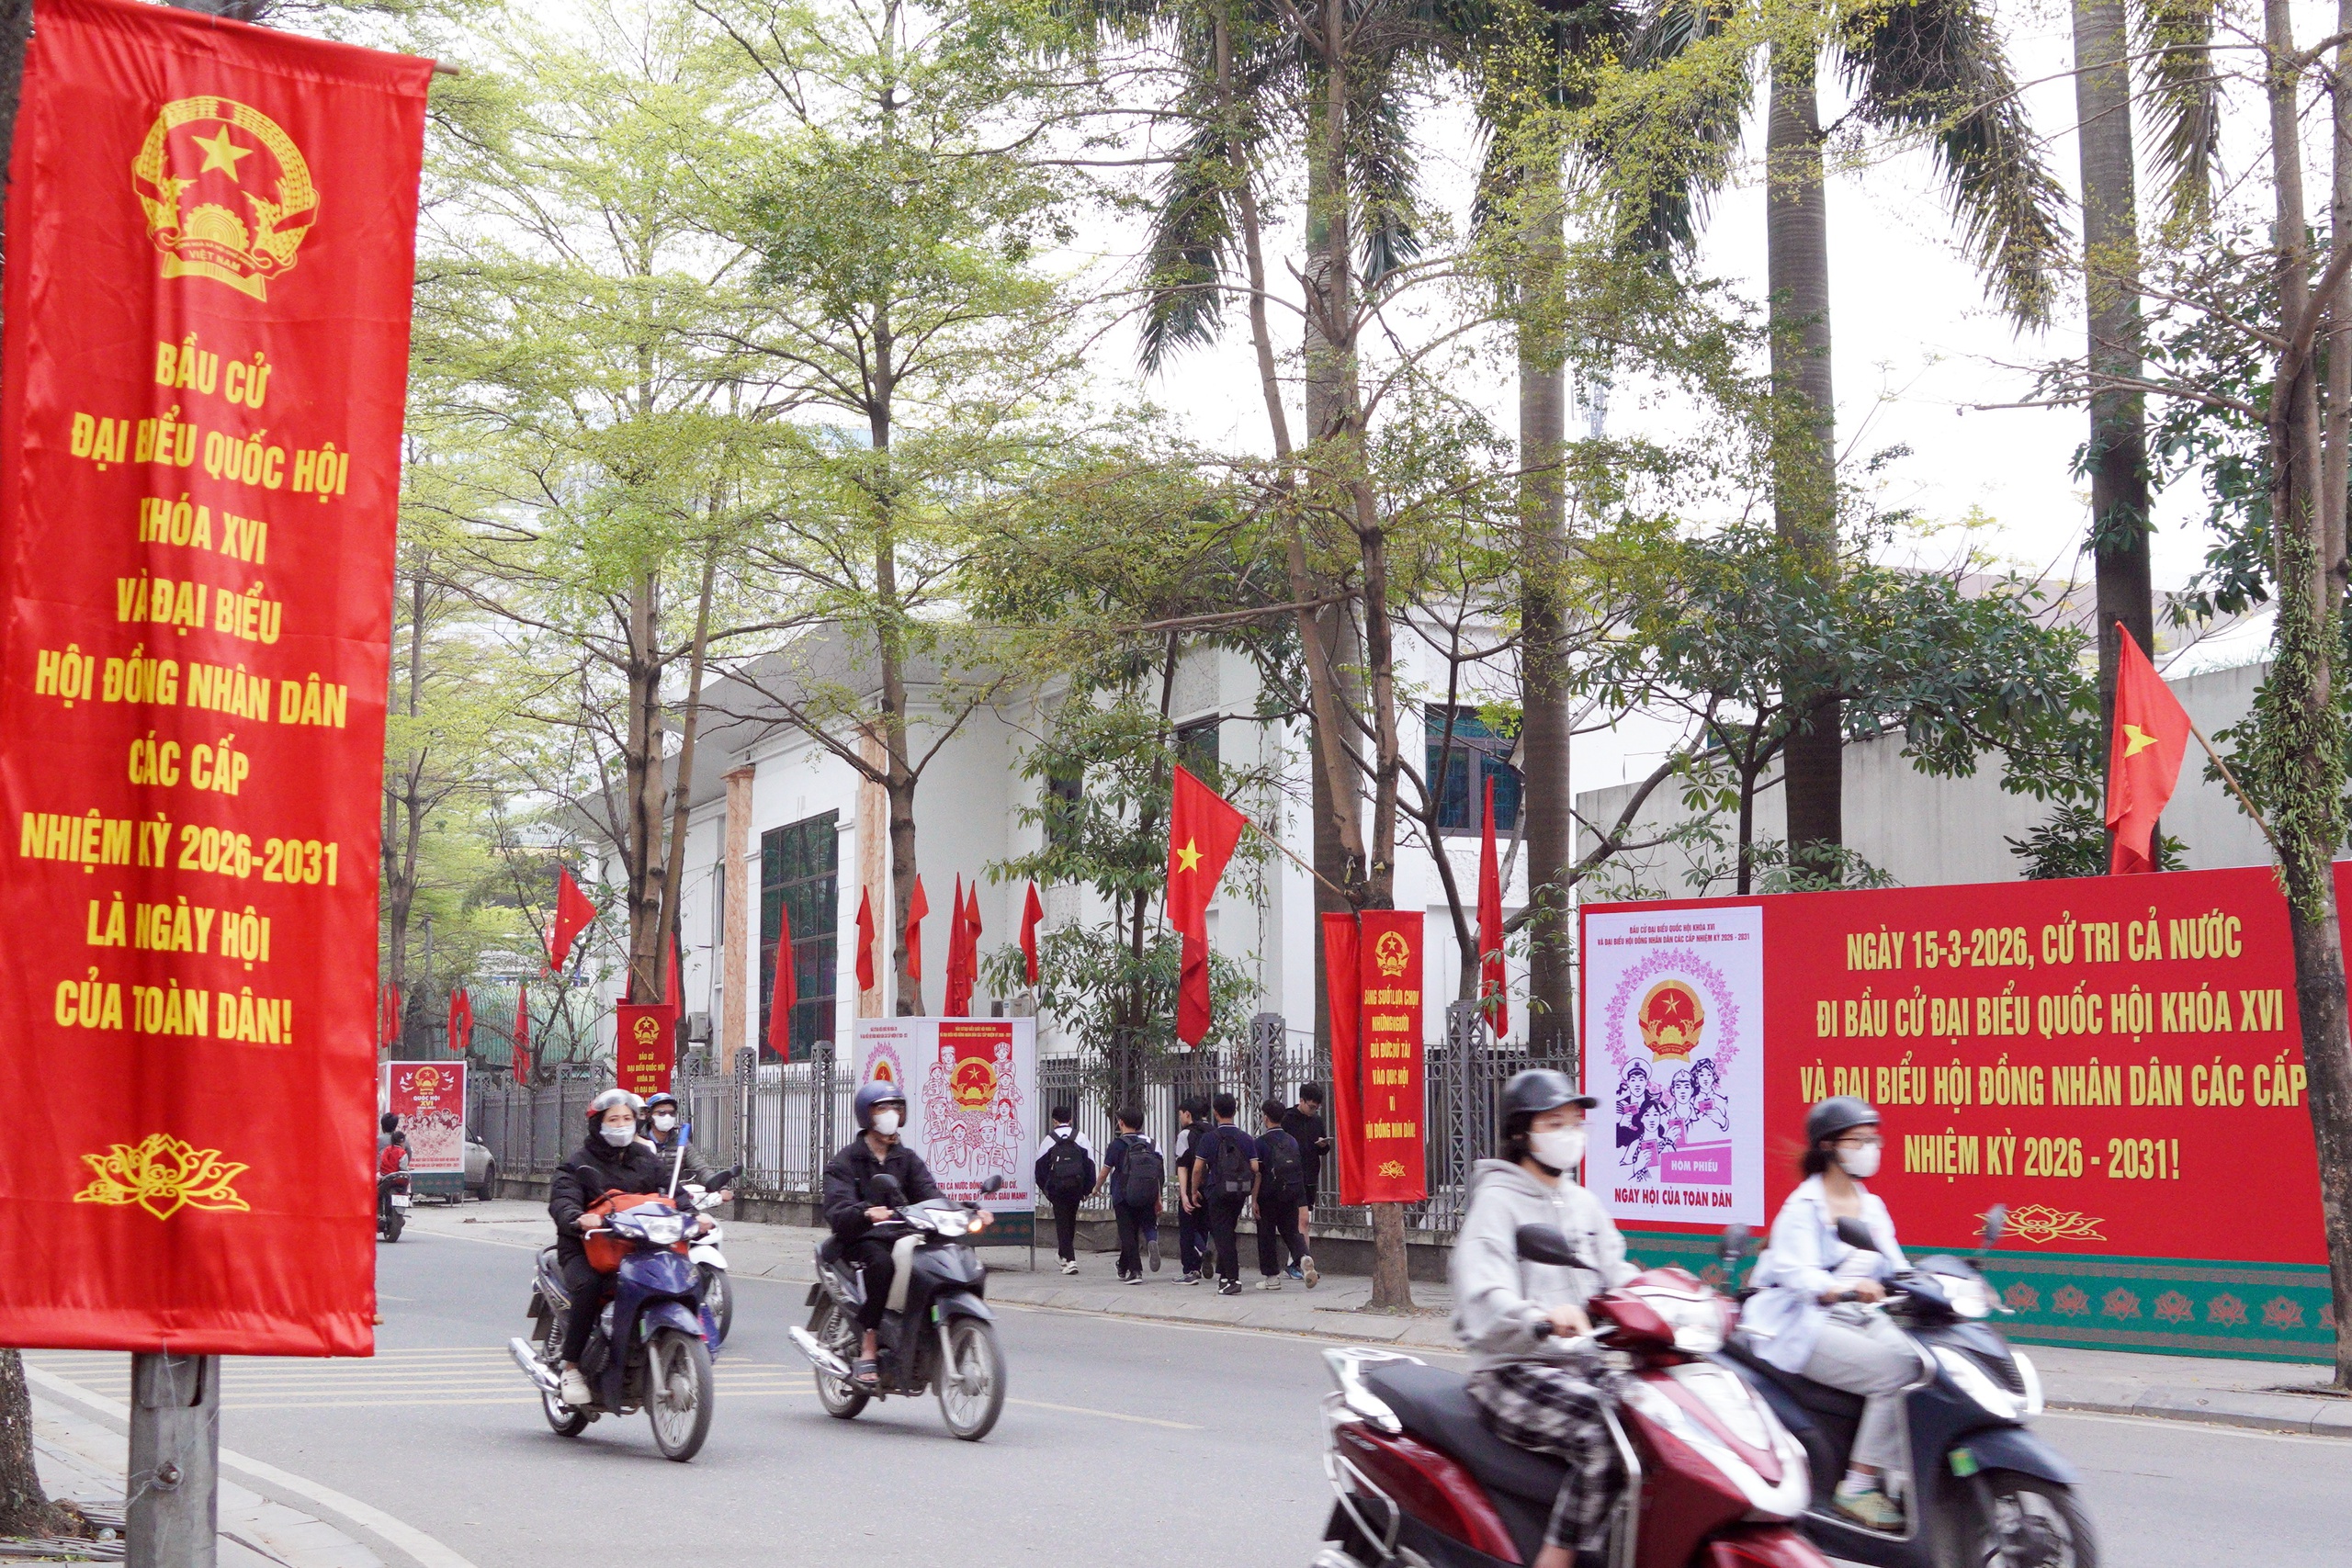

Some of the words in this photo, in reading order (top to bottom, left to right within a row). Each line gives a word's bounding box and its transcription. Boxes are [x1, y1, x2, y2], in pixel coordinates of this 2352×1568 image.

[216, 254, 242, 272] NAM
[154, 331, 220, 396] BẦU
[223, 351, 273, 410] CỬ
[71, 412, 130, 471] ĐẠI
[134, 404, 198, 468] BIỂU
[202, 428, 286, 491] QUỐC
[292, 441, 350, 503] HỘI
[219, 511, 268, 566] XVI
[151, 577, 209, 637] ĐẠI
[213, 580, 282, 645] BIỂU
[35, 643, 95, 708] HỘI
[102, 642, 179, 705] ĐỒNG
[187, 653, 271, 723] NHÂN
[278, 671, 348, 729] DÂN
[129, 730, 181, 787] CÁC
[190, 732, 250, 796] CẤP
[19, 807, 132, 874] NHIỆM
[139, 811, 173, 868] KỲ
[178, 824, 339, 886] 2026-2031
[86, 891, 126, 947] LÀ
[135, 895, 216, 953] NGÀY
[220, 905, 271, 972] HỘI
[1847, 924, 1905, 971] NGÀY
[1912, 927, 2035, 969] 15-3-2026,
[2041, 910, 2077, 964] CỬ
[2081, 922, 2120, 963] TRI
[2128, 906, 2163, 962] CẢ
[2169, 908, 2242, 960] NƯỚC
[54, 965, 122, 1030] CỦA
[132, 977, 209, 1037] TOÀN
[217, 986, 292, 1044] DÂN!
[1816, 1000, 1838, 1038] ĐI
[1845, 985, 1888, 1037] BẦU
[1894, 986, 1927, 1037] CỬ
[1930, 998, 1969, 1044] ĐẠI
[1976, 980, 2030, 1036] BIỂU
[2038, 980, 2103, 1040] QUỐC
[2110, 984, 2154, 1043] HỘI
[2161, 982, 2233, 1033] KHÓA
[2239, 989, 2284, 1032] XVI
[1397, 1066, 1409, 1088] HỘI
[1800, 1058, 1827, 1103] VÀ
[1876, 1050, 1927, 1105] BIỂU
[1933, 1058, 1972, 1114] HỘI
[1978, 1053, 2044, 1106] ĐỒNG
[2052, 1057, 2121, 1106] NHÂN
[2129, 1056, 2183, 1106] DÂN
[2191, 1055, 2245, 1107] CÁC
[2253, 1048, 2308, 1107] CẤP
[1671, 1158, 1691, 1172] HÒM
[1693, 1158, 1718, 1172] PHIẾU
[1905, 1126, 1979, 1183] NHIỆM
[1986, 1127, 2017, 1176] KỲ
[2024, 1136, 2083, 1178] 2026
[2108, 1138, 2179, 1179] 2031!
[1614, 1185, 1640, 1203] NGÀY
[1642, 1186, 1659, 1209] HỘI
[1662, 1186, 1680, 1206] CỦA
[1682, 1188, 1709, 1207] TOÀN
[1712, 1189, 1733, 1208] DÂN
